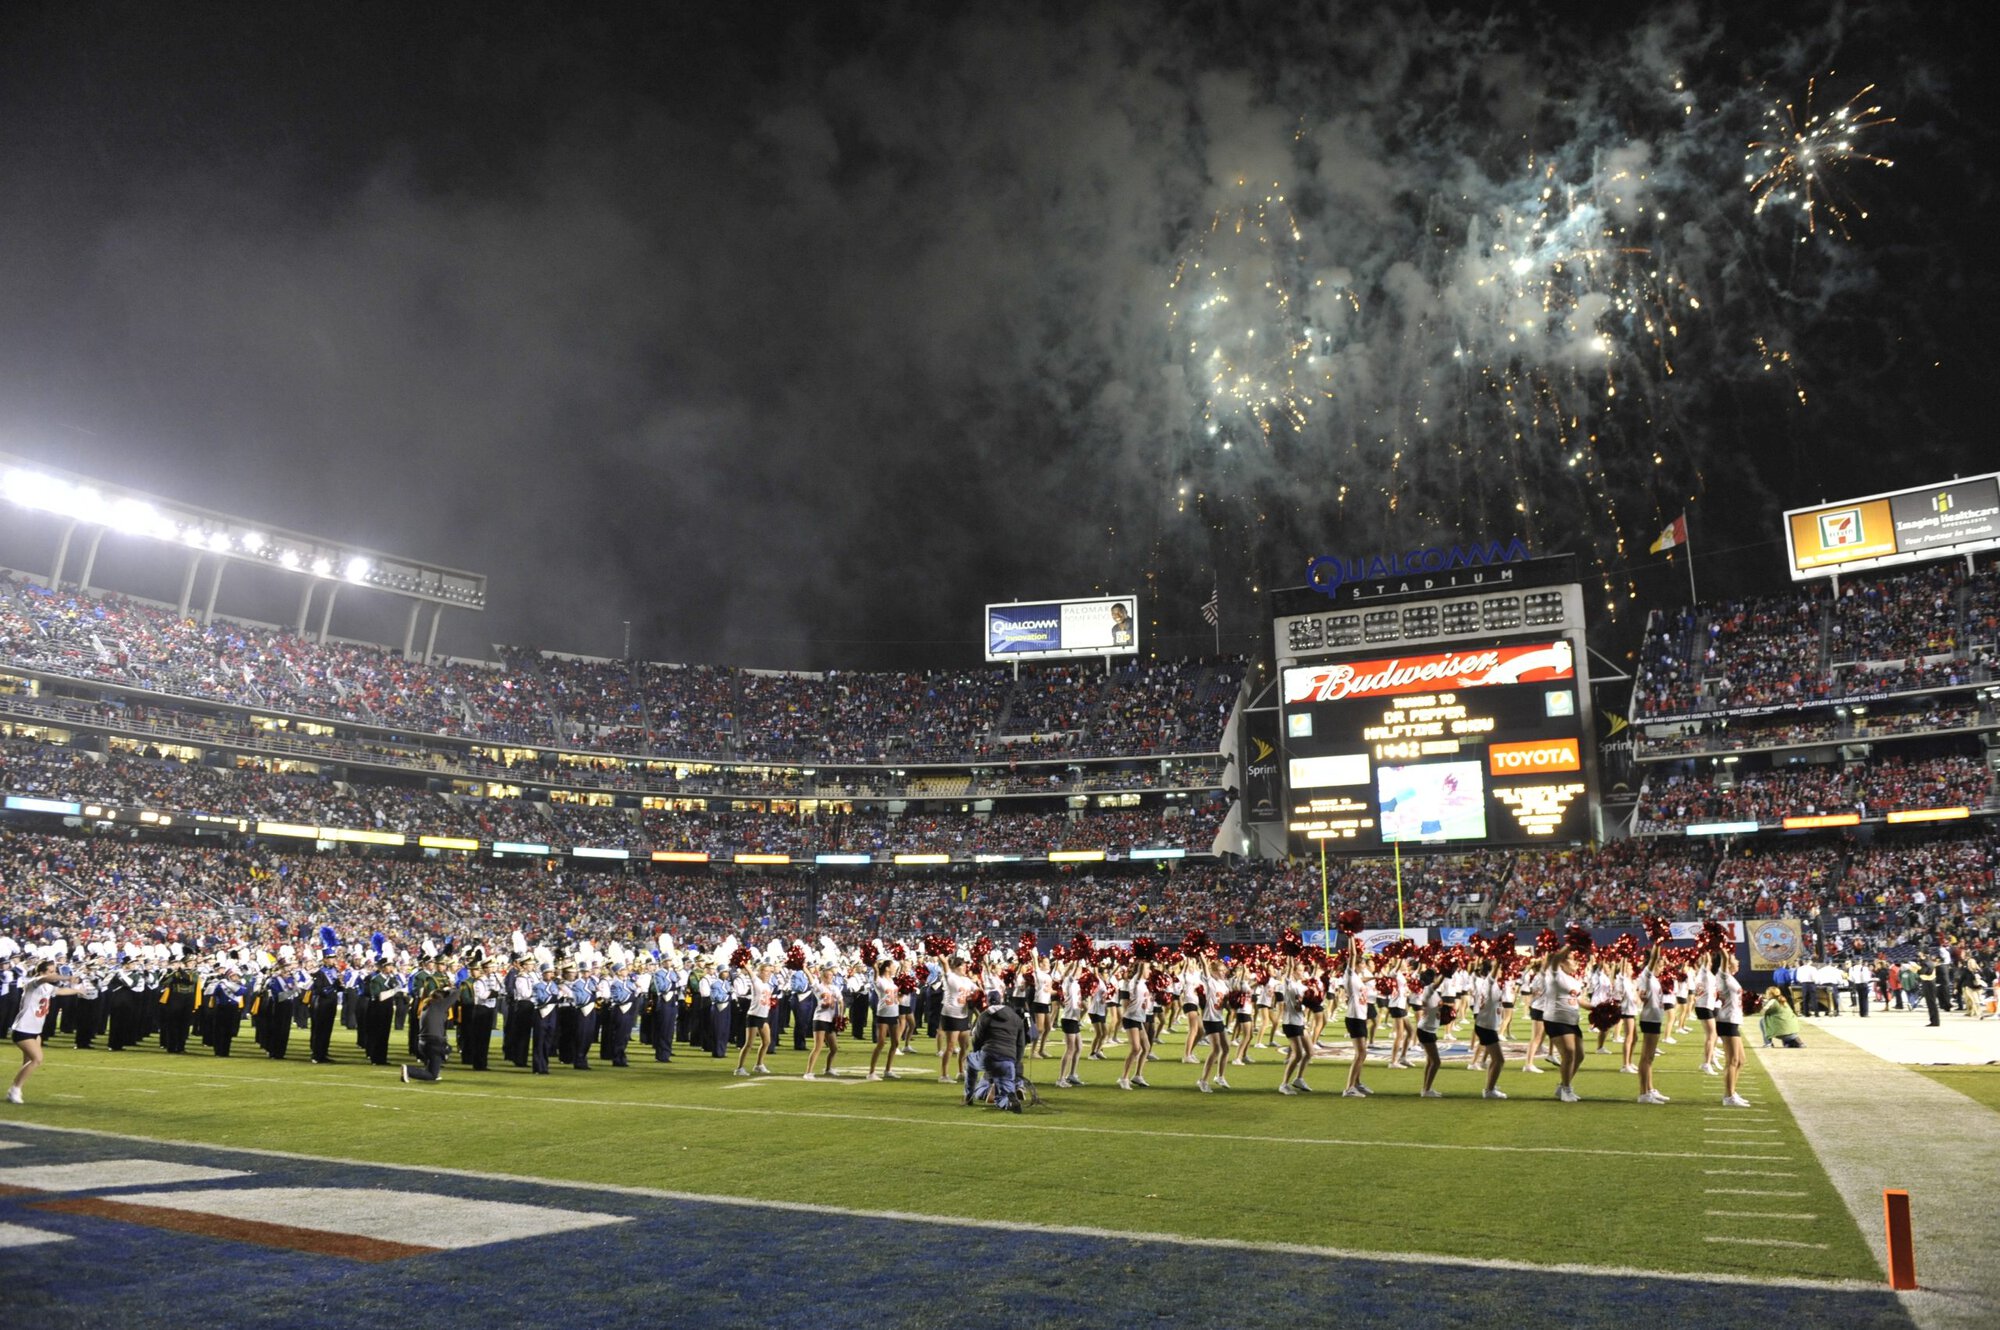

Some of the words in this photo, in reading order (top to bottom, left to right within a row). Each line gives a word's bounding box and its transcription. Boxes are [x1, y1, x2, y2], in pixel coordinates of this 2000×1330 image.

[1897, 517, 1940, 531] Imaging
[1940, 507, 1999, 523] Healthcare
[1306, 537, 1531, 599] QUALCOMM
[1352, 569, 1513, 598] STADIUM
[992, 620, 1058, 635] QUALCOMM
[1312, 652, 1499, 701] Budweiser
[1439, 693, 1456, 705] TO
[1802, 699, 1830, 708] OCATION
[1384, 710, 1406, 724] DR
[1410, 705, 1467, 722] PEPPER
[1712, 709, 1726, 718] TEXT
[1364, 722, 1444, 740] HALFTIME
[1451, 717, 1495, 734] SHOW
[1494, 748, 1575, 768] TOYOTA
[1248, 764, 1278, 777] Sprint
